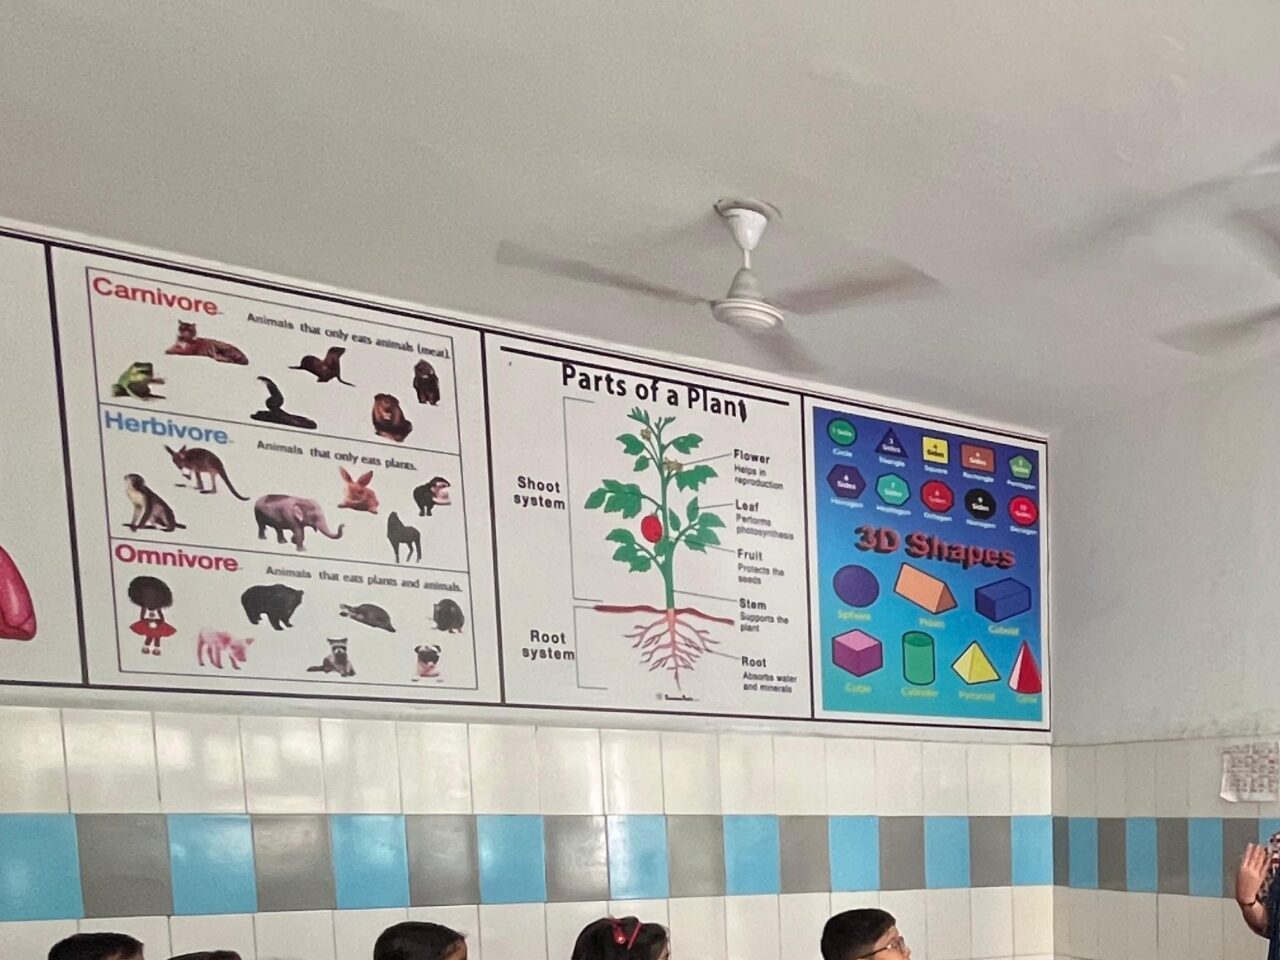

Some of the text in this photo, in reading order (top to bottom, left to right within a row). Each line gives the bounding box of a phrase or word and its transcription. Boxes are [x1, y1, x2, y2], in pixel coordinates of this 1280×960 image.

[93, 276, 219, 316] Carnivore
[247, 313, 294, 330] Animals
[300, 323, 321, 335] that
[325, 329, 348, 341] only
[352, 334, 373, 344] eats
[375, 339, 413, 352] animals
[562, 362, 627, 397] Parts
[635, 377, 660, 402] of
[666, 389, 679, 406] a
[104, 410, 229, 445] Herbivore
[257, 440, 303, 455] Animals
[310, 448, 330, 459] that
[334, 452, 359, 464] only
[361, 456, 382, 466] eats
[734, 448, 770, 464] Flower
[734, 464, 757, 476] Helps
[517, 475, 561, 493] Shoot
[735, 476, 784, 490] reproduction
[513, 494, 565, 510] system
[735, 499, 759, 512] Leaf
[854, 524, 1016, 569] 3D Shapes
[115, 544, 239, 572] Omnivore
[737, 548, 762, 561] Fruit
[266, 566, 312, 579] Animals
[319, 571, 339, 582] that
[343, 574, 364, 584] eats
[368, 575, 397, 587] plants
[401, 579, 420, 589] and
[739, 598, 767, 610] Stem
[740, 622, 760, 632] plant
[776, 615, 789, 624] the
[530, 629, 566, 644] Root
[522, 647, 575, 660] system
[741, 656, 767, 668] Root
[743, 671, 797, 683] Absorbs water
[743, 682, 757, 691] and
